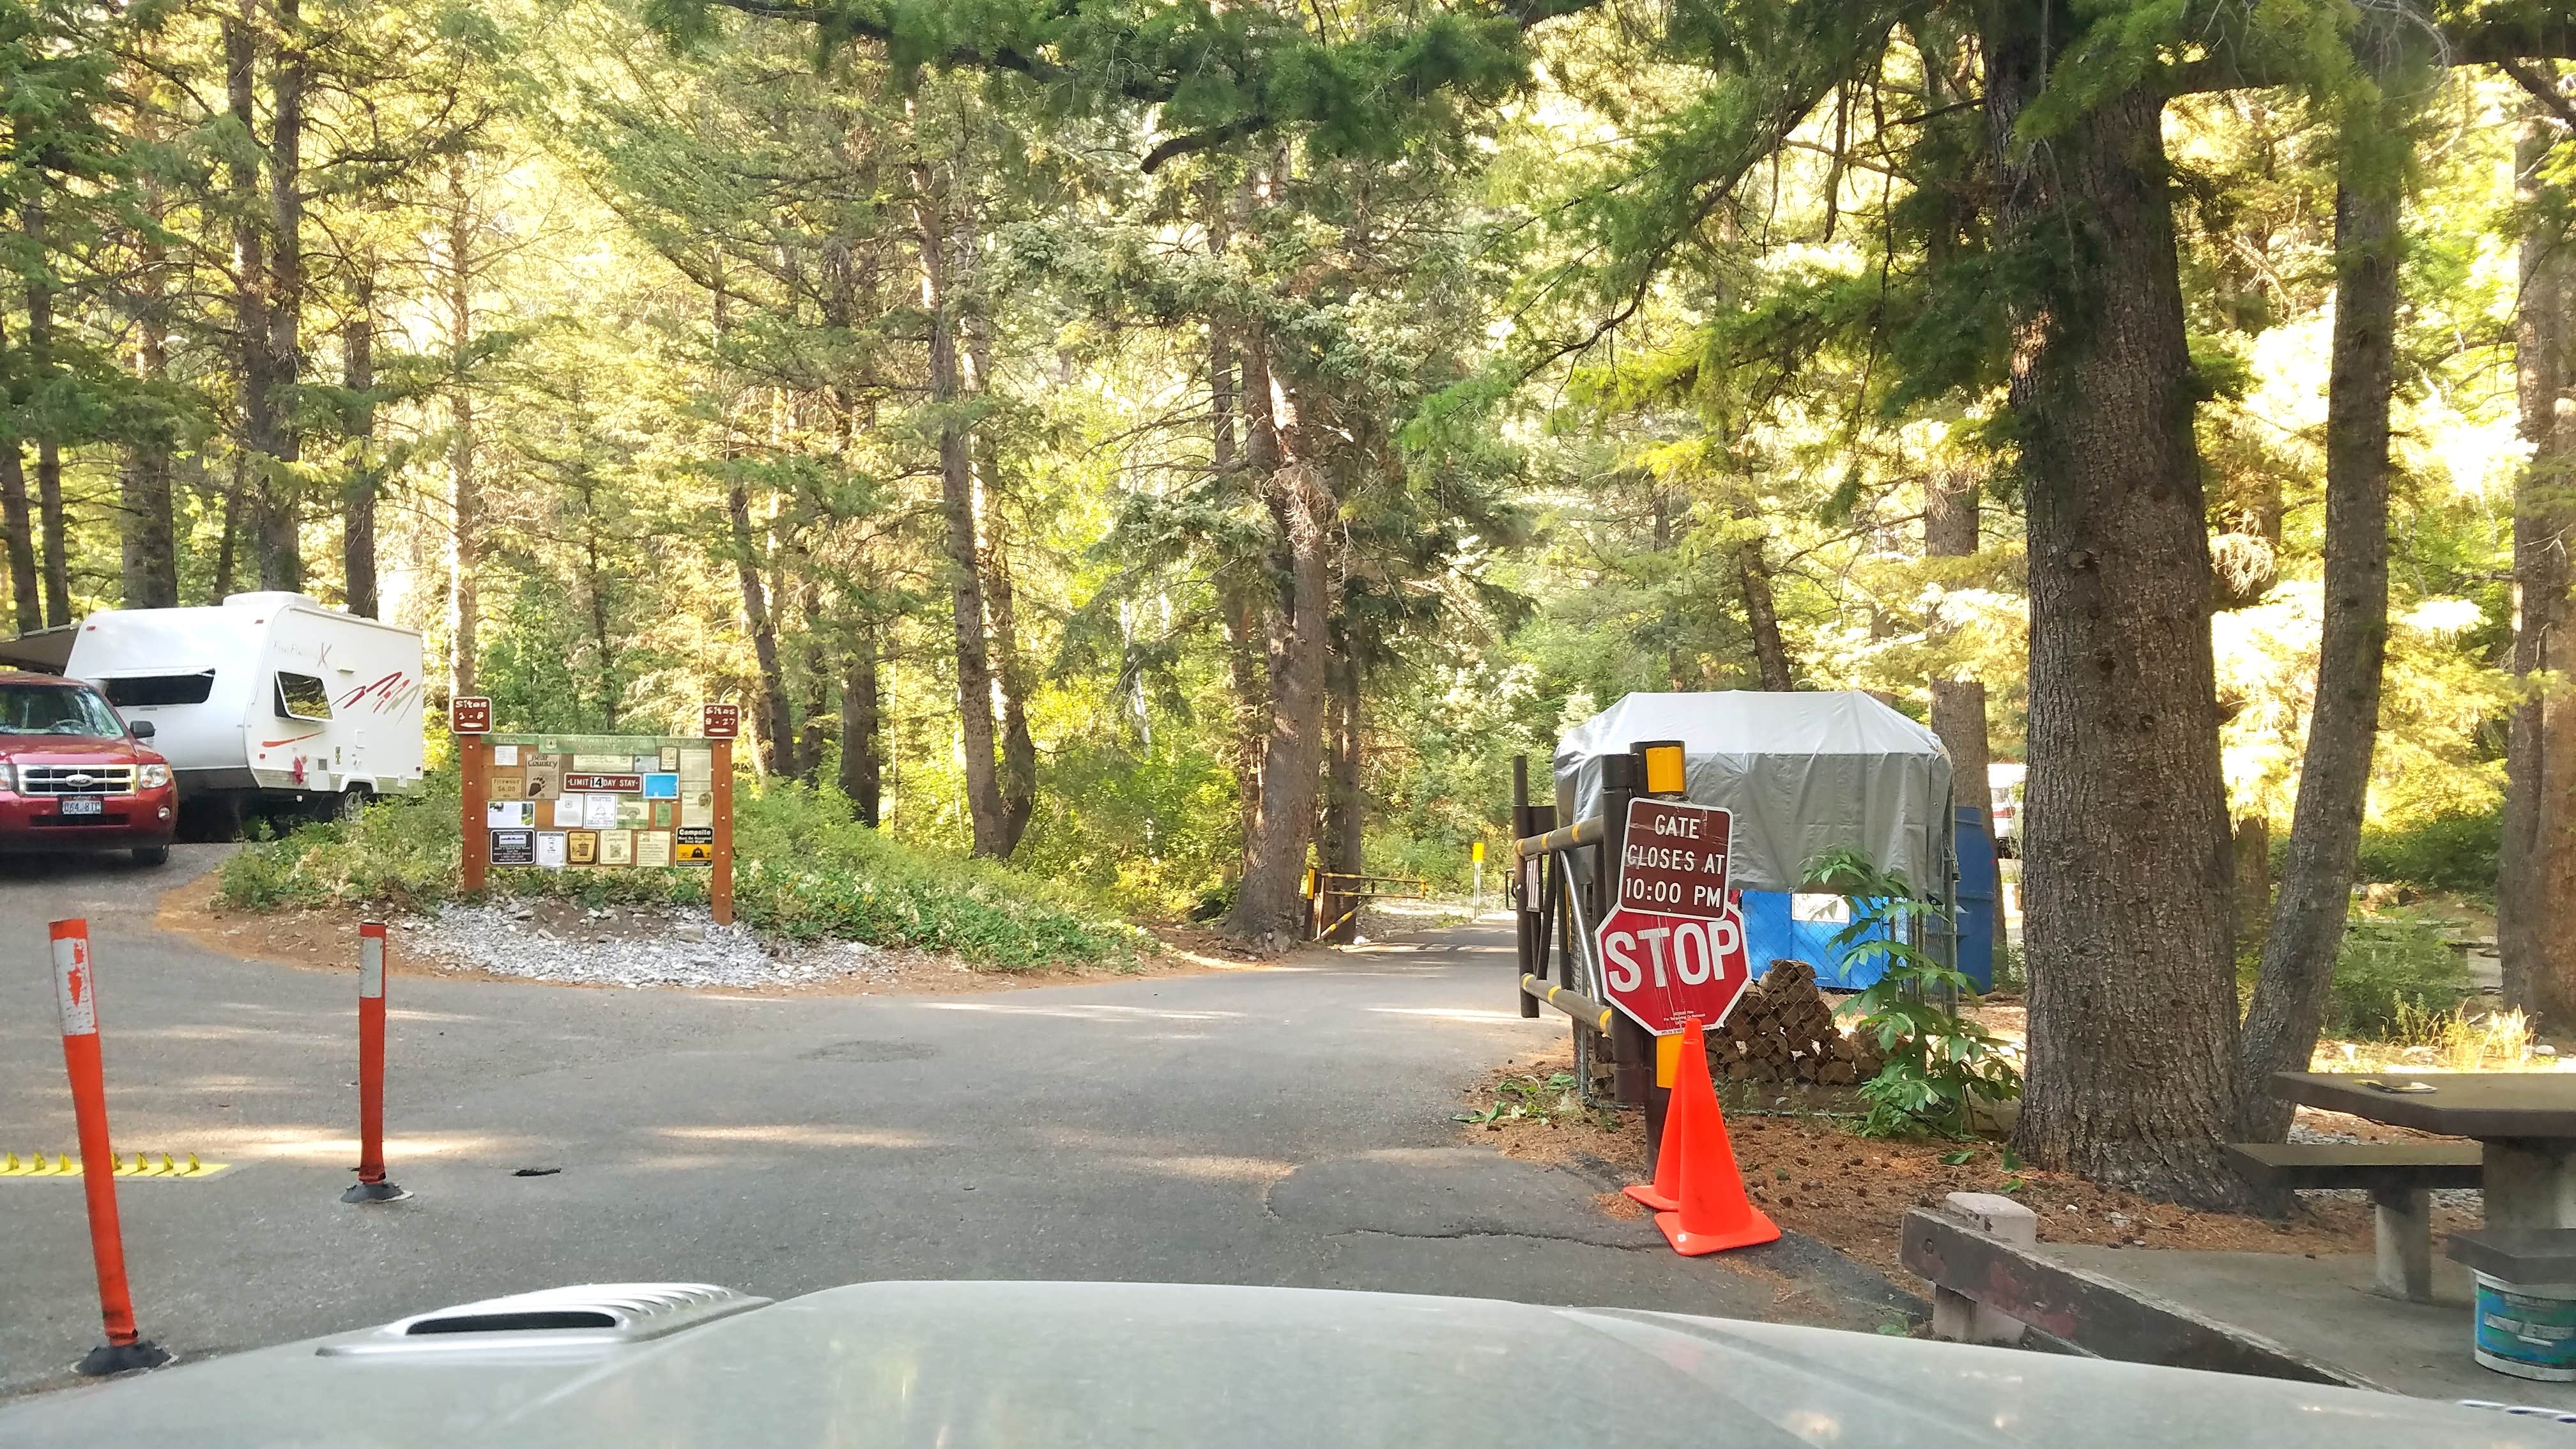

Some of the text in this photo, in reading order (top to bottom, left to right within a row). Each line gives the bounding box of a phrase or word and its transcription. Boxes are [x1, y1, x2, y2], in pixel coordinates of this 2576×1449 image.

[456, 700, 487, 709] Sites
[705, 707, 735, 715] Sites
[528, 760, 558, 769] Country
[592, 778, 602, 786] 14
[619, 779, 635, 787] STAY
[1655, 815, 1700, 839] GATE
[1627, 844, 1725, 875] CLOSES AT
[1626, 878, 1721, 908] 10:00 PM
[1605, 919, 1740, 992] STOP
